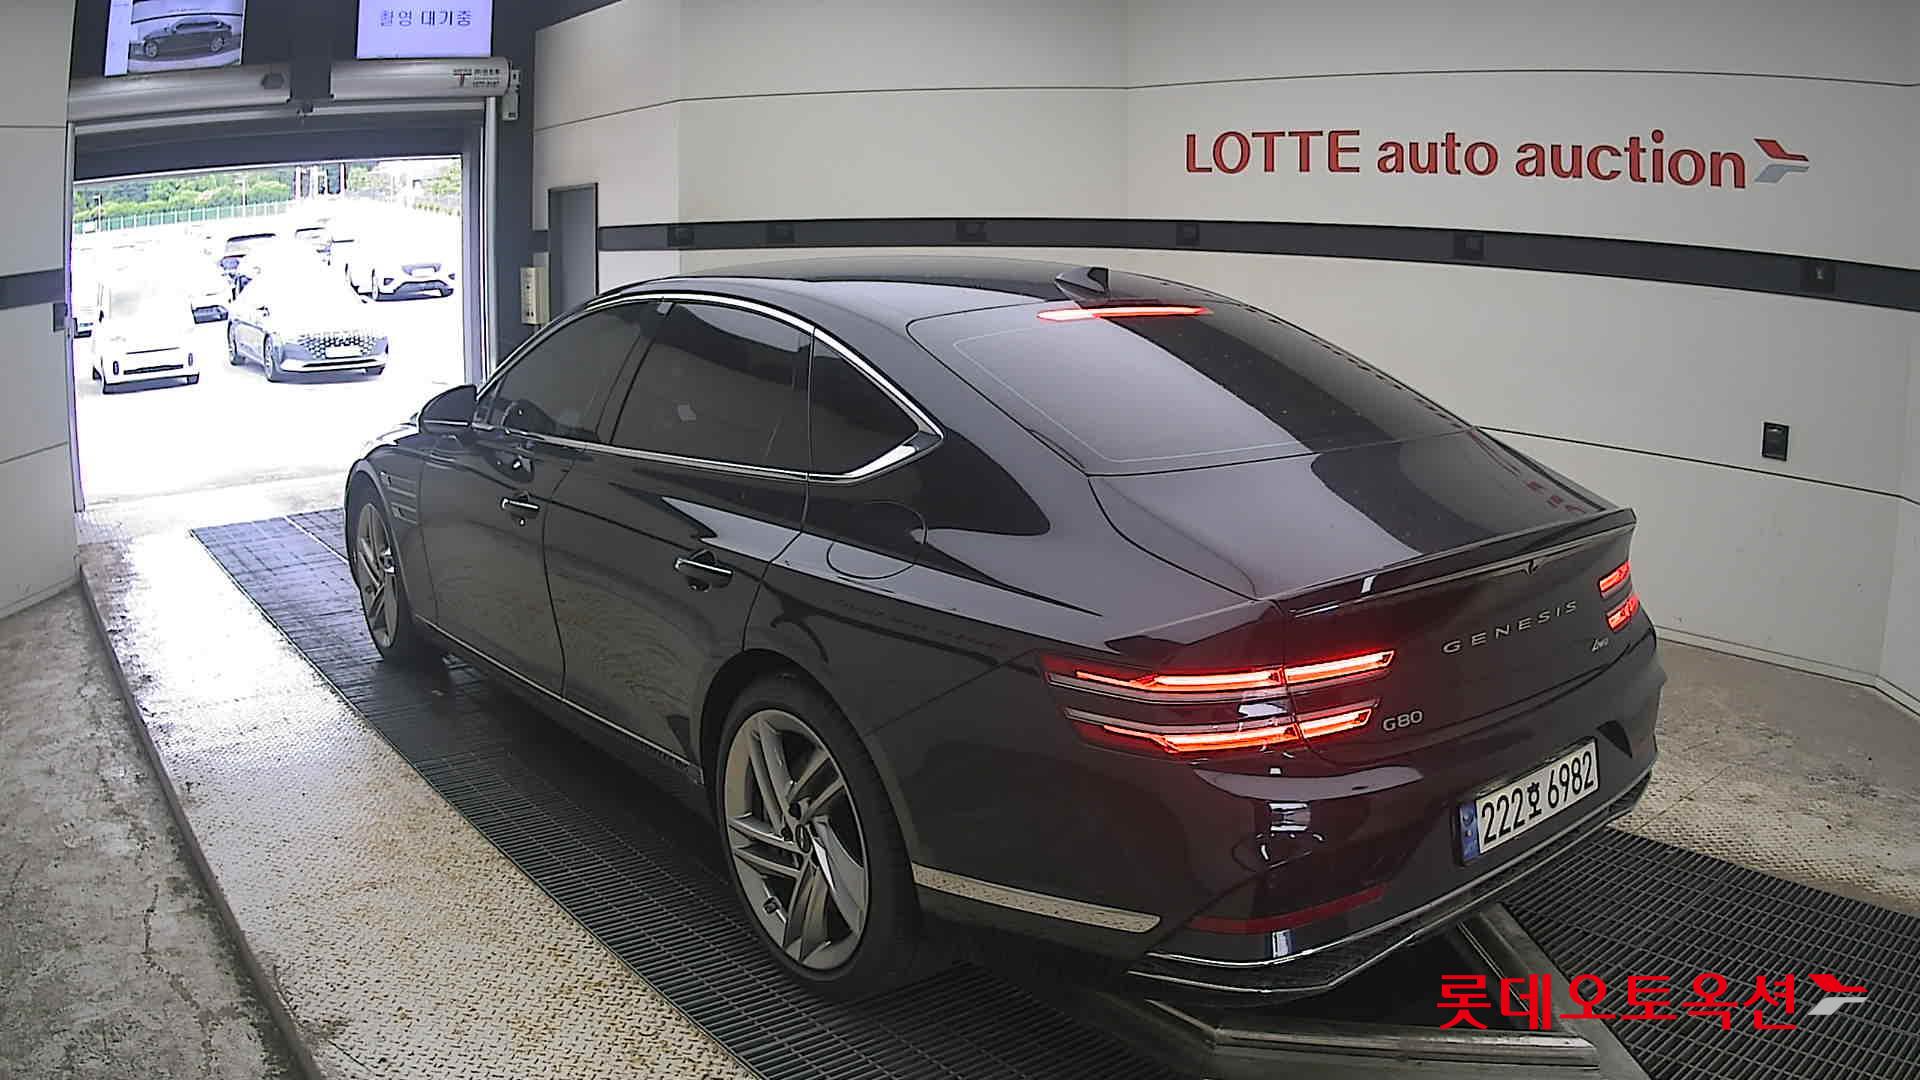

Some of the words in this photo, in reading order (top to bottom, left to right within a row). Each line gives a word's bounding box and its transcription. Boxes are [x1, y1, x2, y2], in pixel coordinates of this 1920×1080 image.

[421, 10, 472, 26] 대기중
[1186, 130, 1361, 174] LOTTE
[1377, 132, 1499, 176] auto
[1516, 130, 1746, 189] auction
[1442, 599, 1578, 654] GENESIS
[1382, 709, 1425, 732] G80
[1481, 782, 1543, 845] 222호
[1547, 750, 1595, 809] 6982
